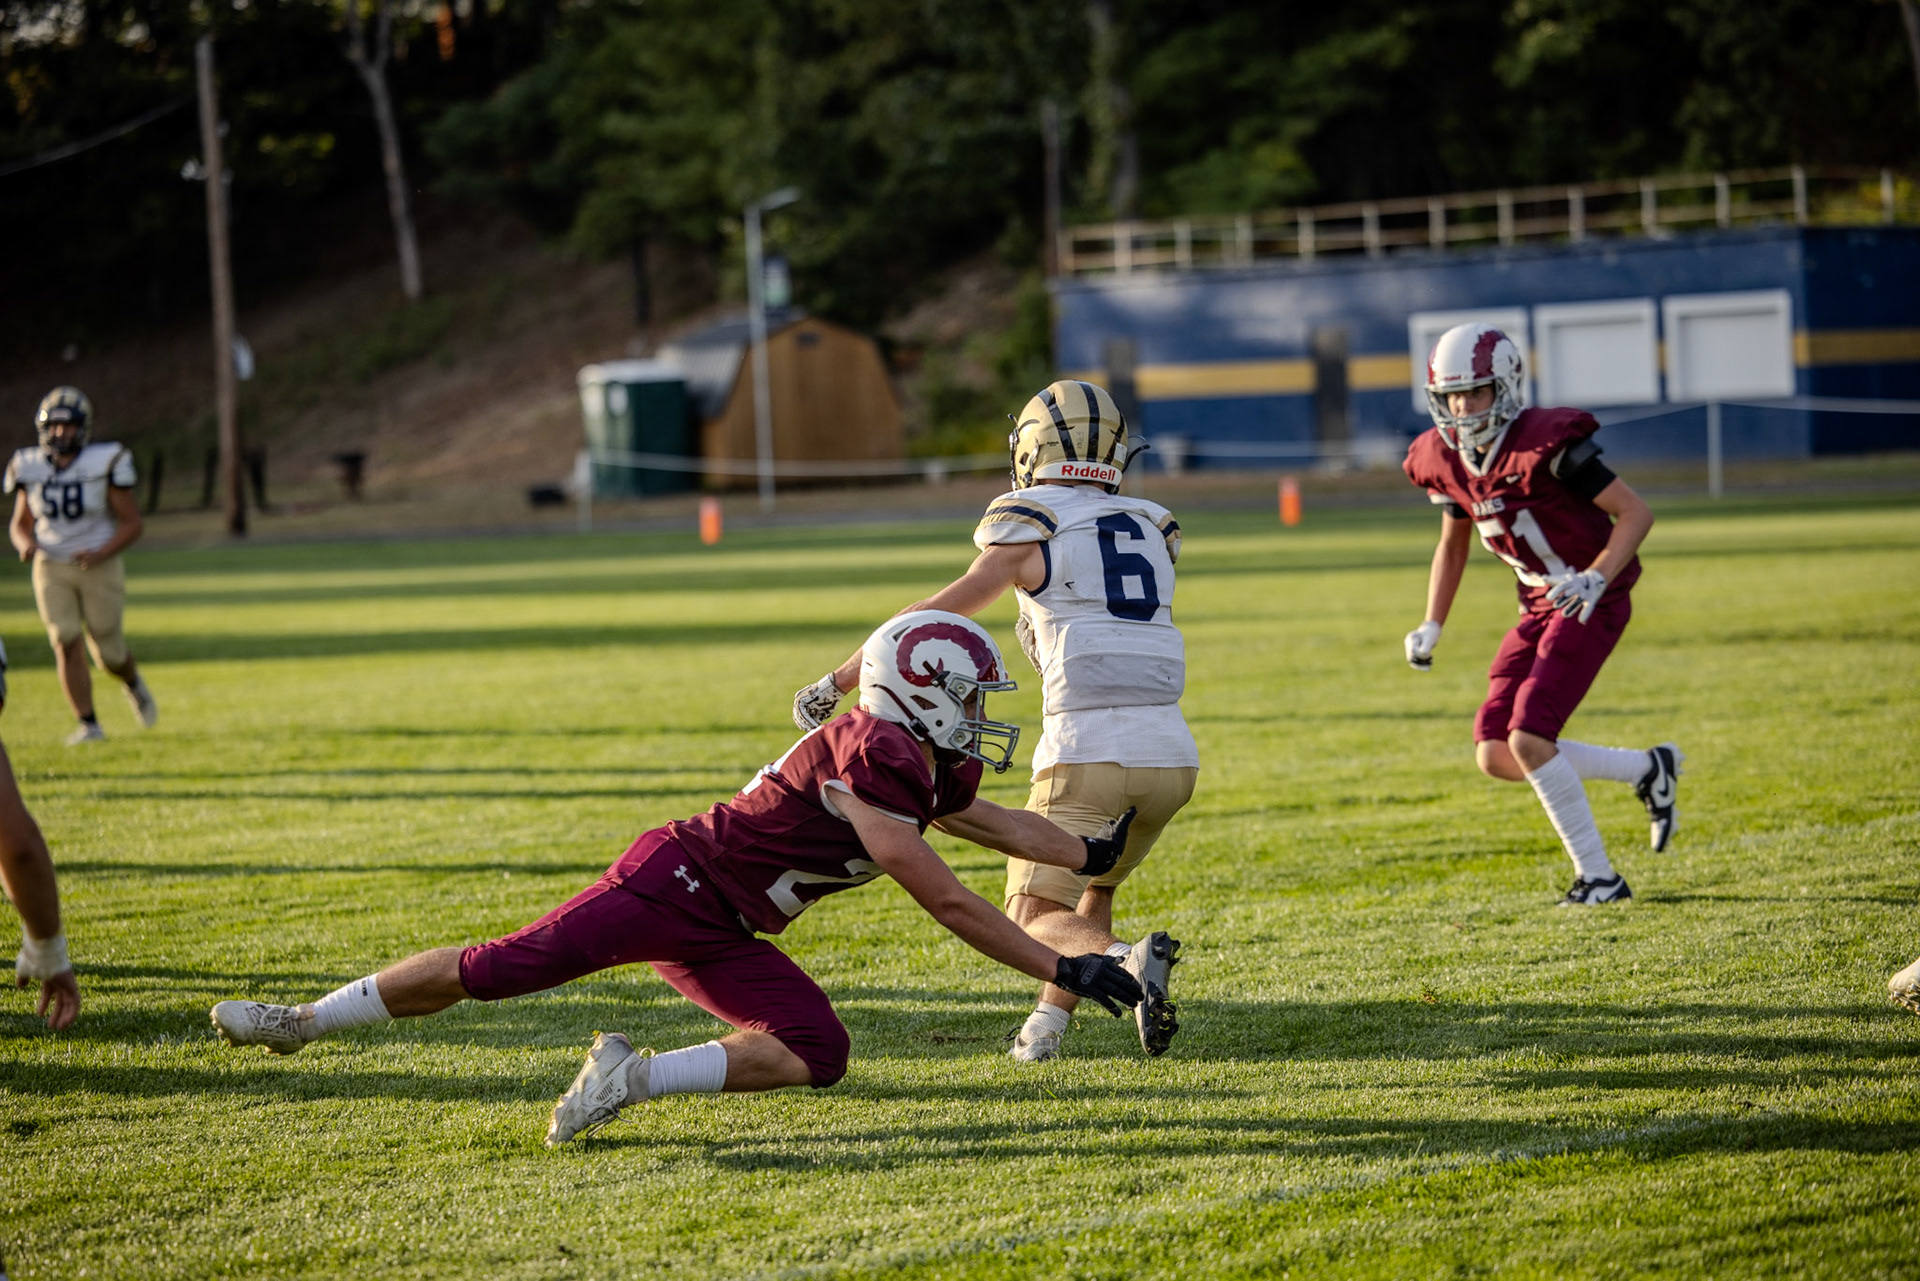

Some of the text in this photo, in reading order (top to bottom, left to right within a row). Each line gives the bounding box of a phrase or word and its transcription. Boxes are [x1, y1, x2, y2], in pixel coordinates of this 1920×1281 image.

[1061, 464, 1116, 481] Riddell
[43, 481, 83, 519] 58
[1095, 511, 1161, 622] 6
